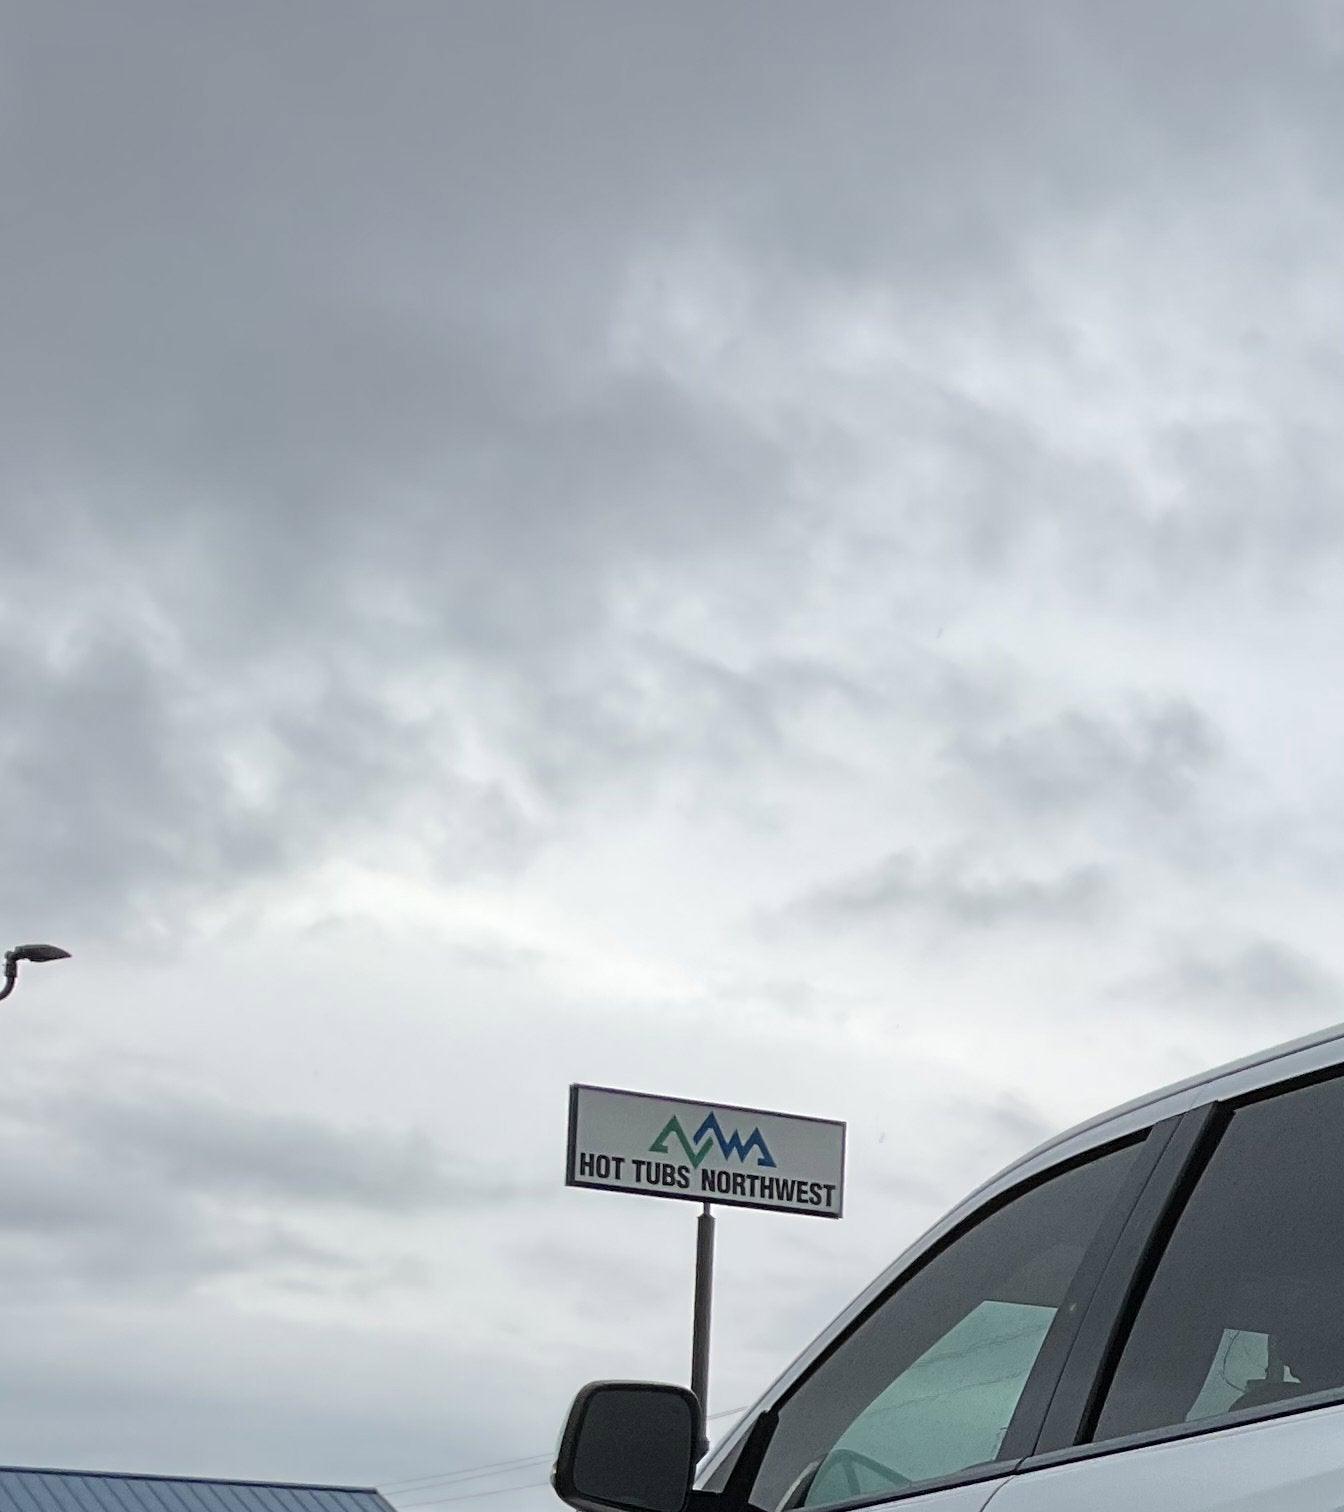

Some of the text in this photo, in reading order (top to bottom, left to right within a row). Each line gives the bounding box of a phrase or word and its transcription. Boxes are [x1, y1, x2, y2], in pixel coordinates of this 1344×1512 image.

[579, 1152, 837, 1208] HOT TUBS NORTHWEST
